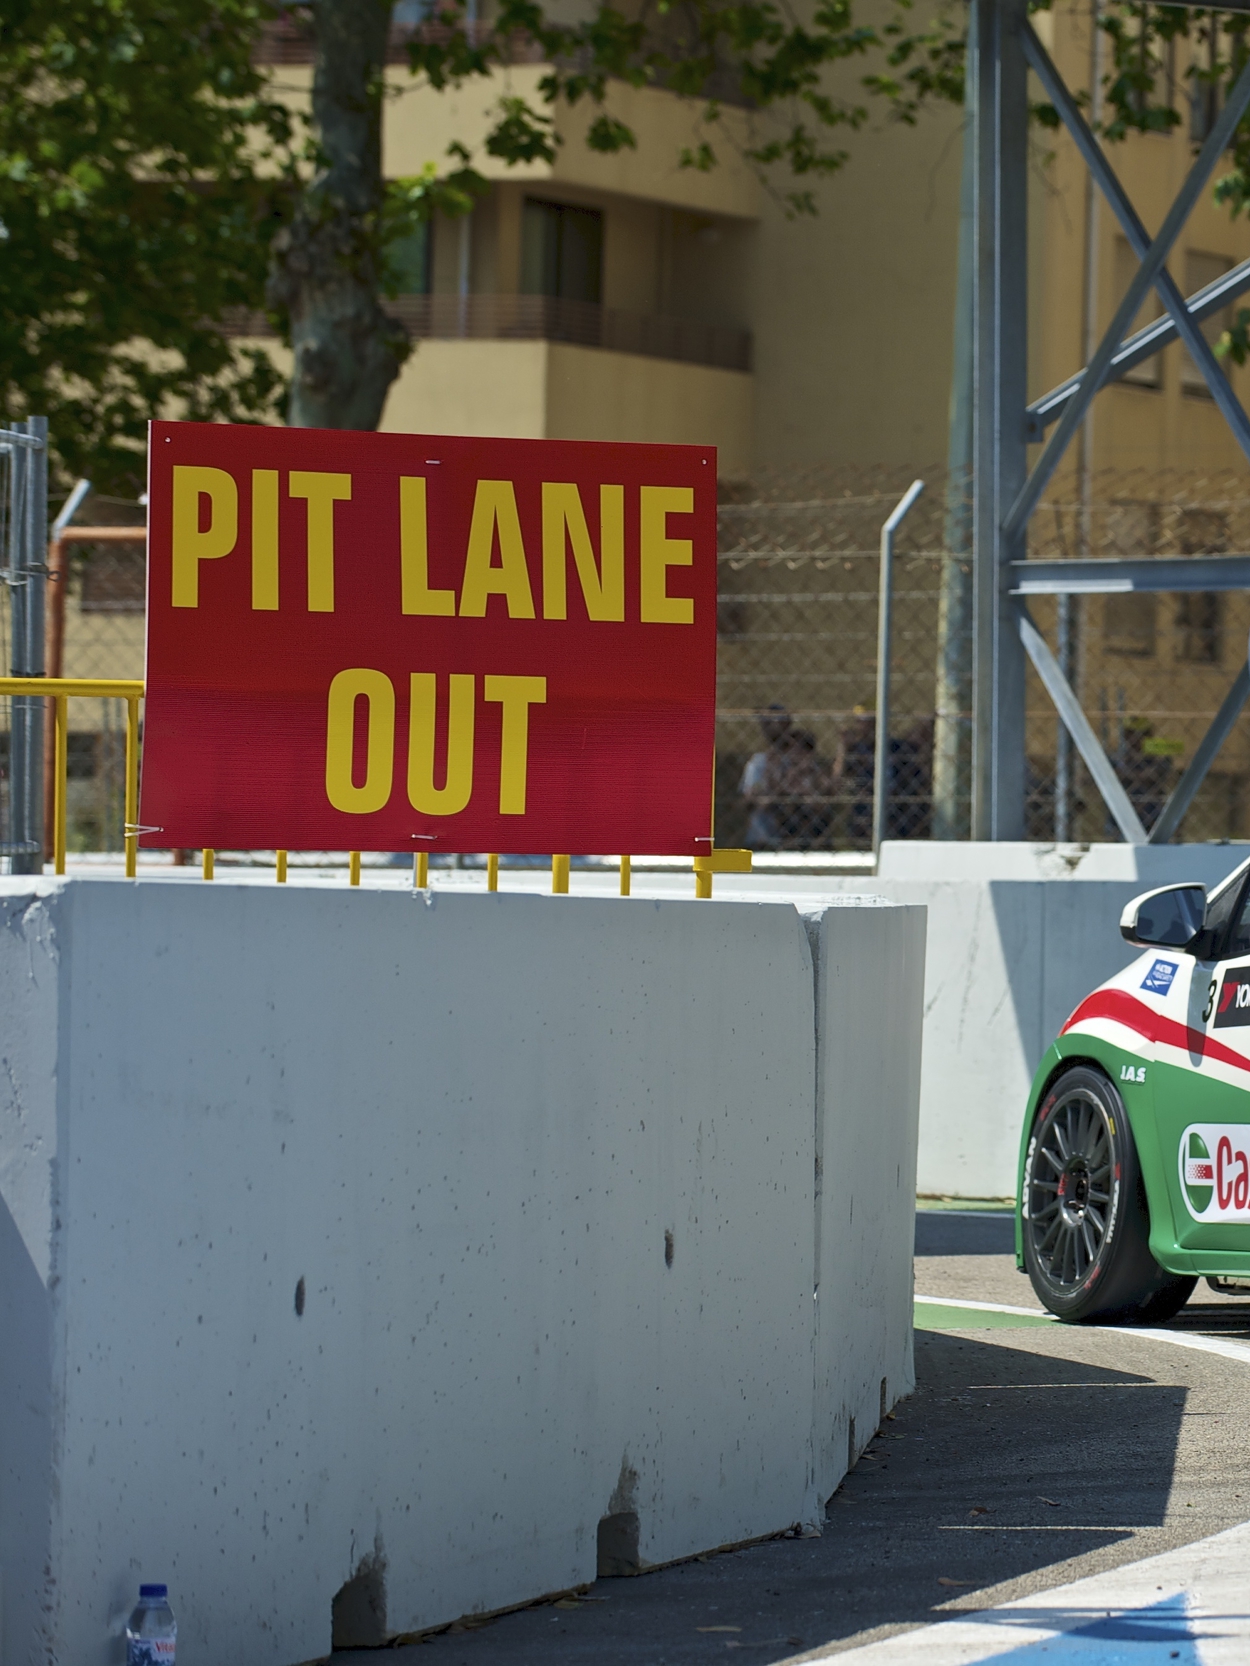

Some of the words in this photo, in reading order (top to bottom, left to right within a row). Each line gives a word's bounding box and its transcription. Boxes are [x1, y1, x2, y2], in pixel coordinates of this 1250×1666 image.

[172, 465, 352, 612] PIT
[400, 476, 694, 624] LANE
[326, 668, 546, 815] OUT
[1202, 979, 1217, 1023] 3
